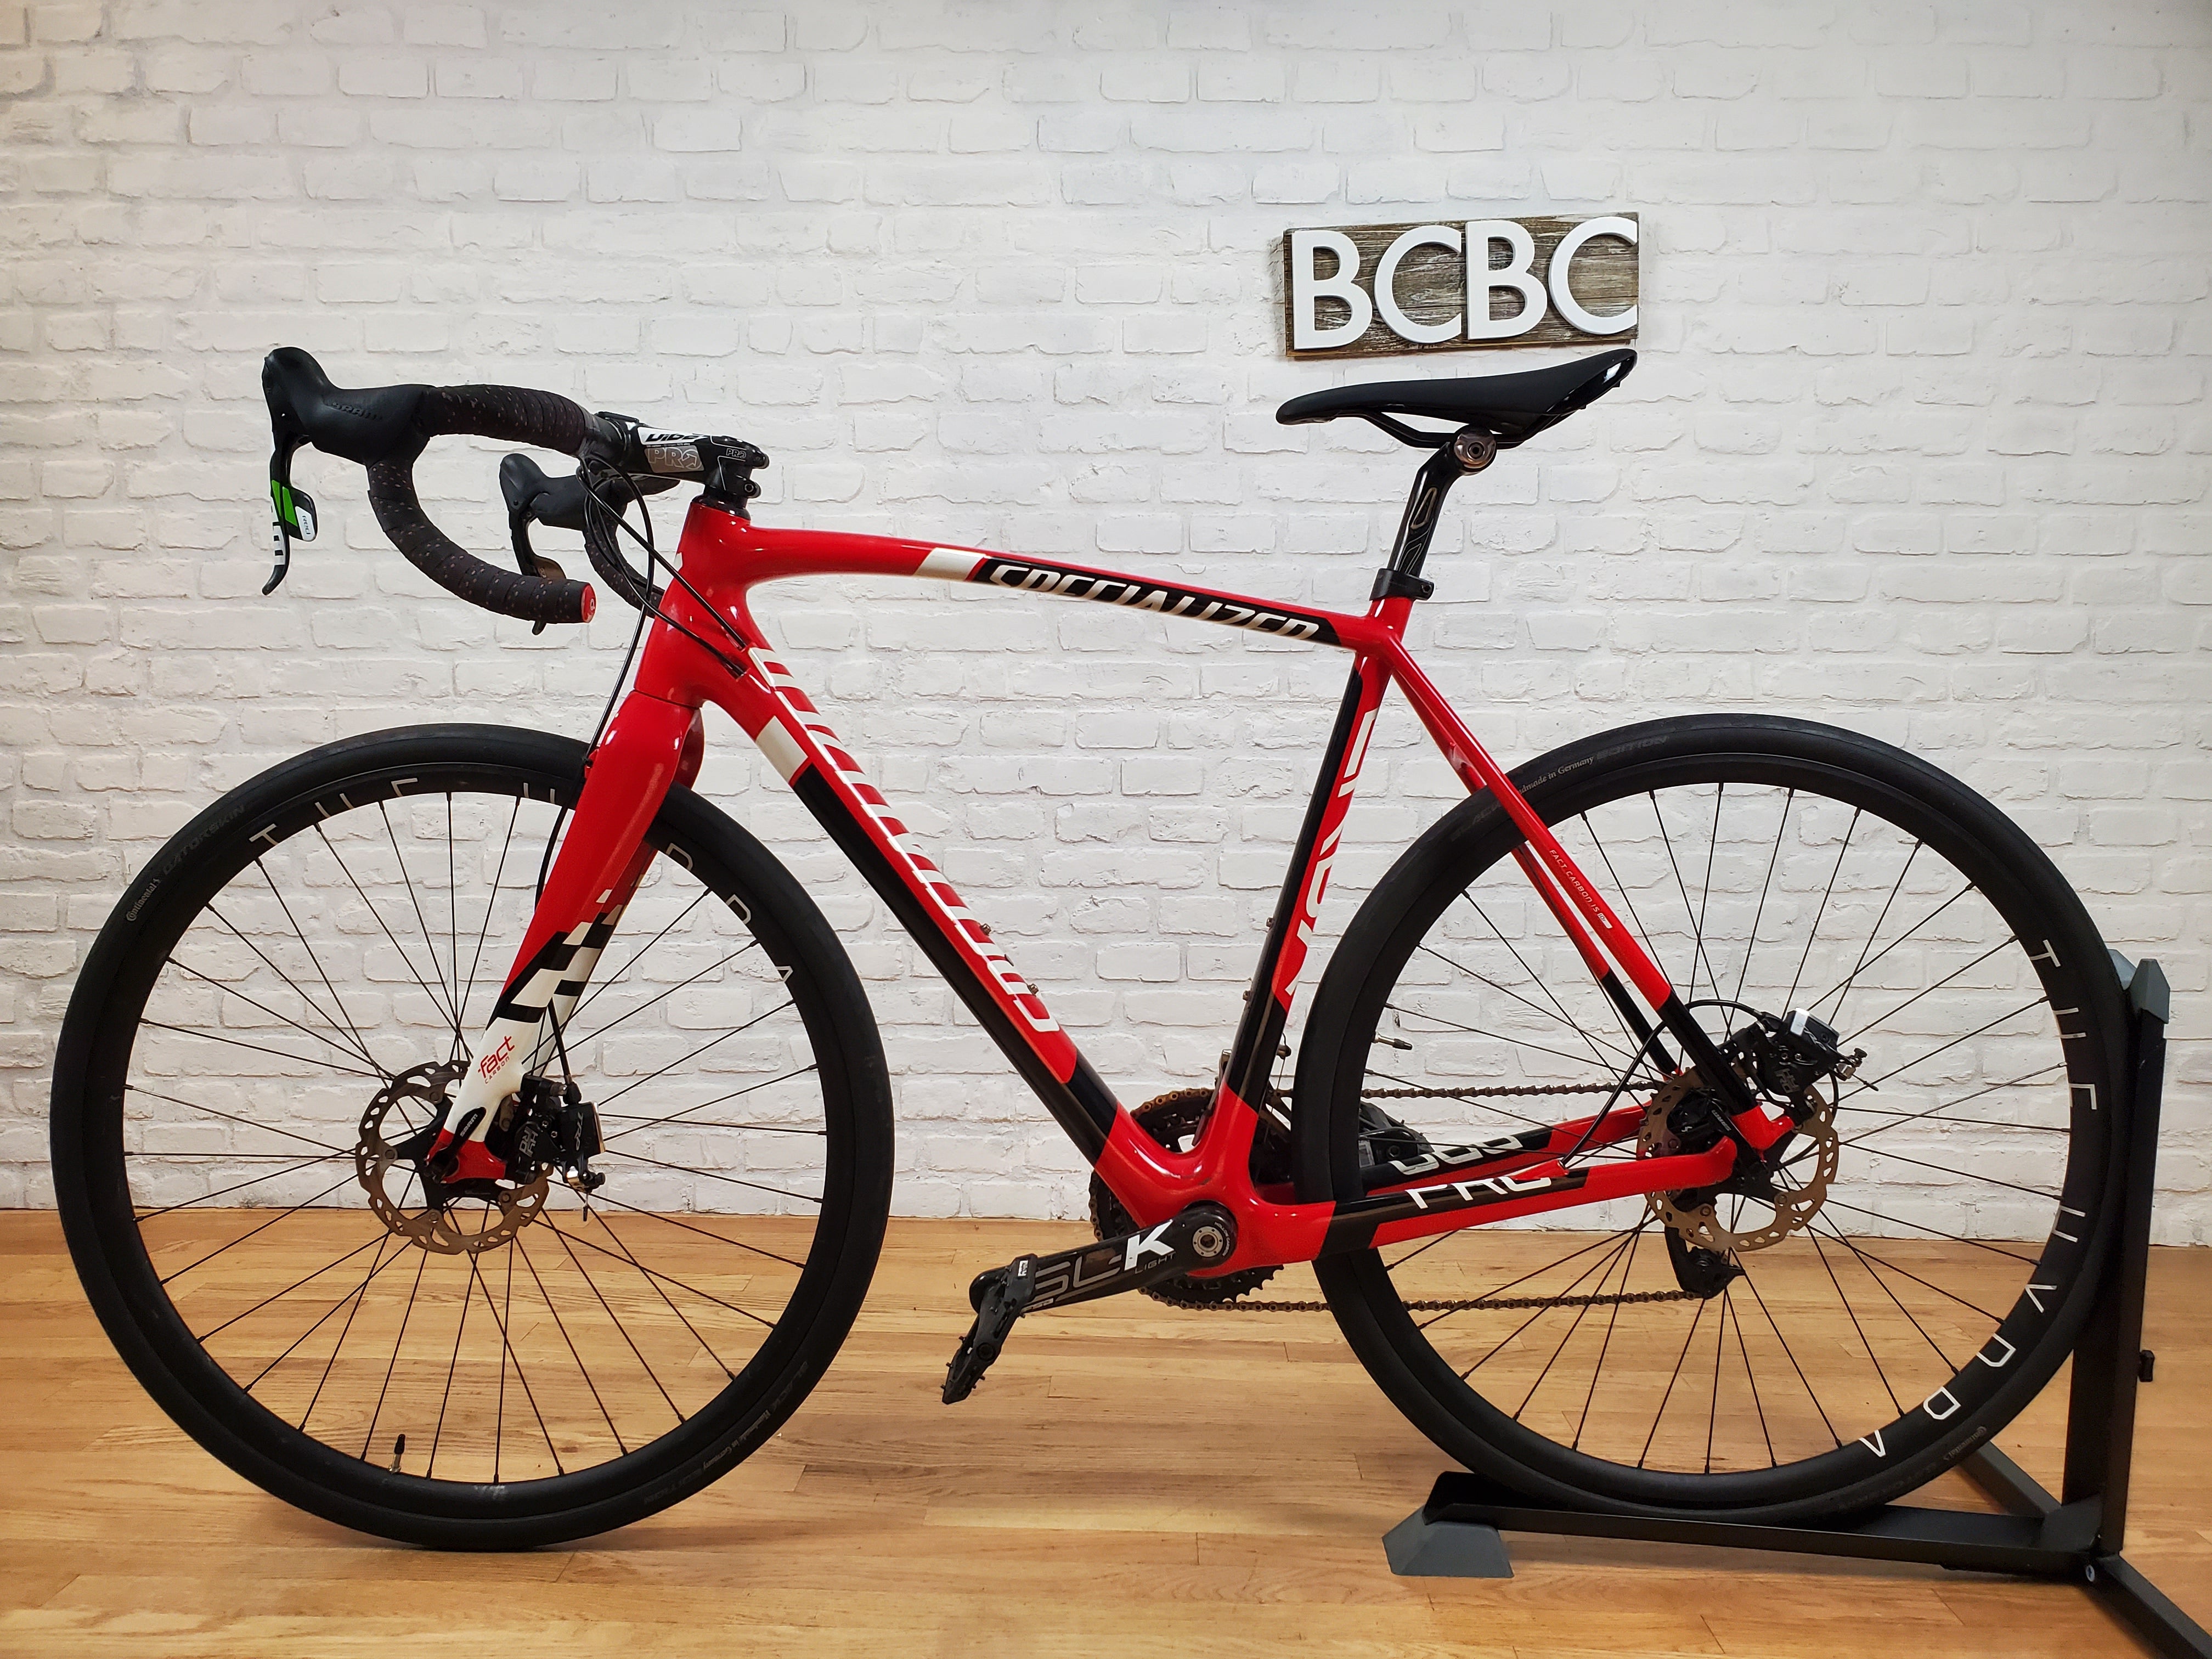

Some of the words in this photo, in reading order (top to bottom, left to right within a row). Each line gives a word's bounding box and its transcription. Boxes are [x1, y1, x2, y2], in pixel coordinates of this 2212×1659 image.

[1291, 216, 1638, 350] BCBC
[648, 446, 702, 470] PRO
[726, 448, 747, 459] PRO
[1558, 755, 1594, 775] Germany
[1550, 850, 1567, 868] FACT
[125, 879, 159, 922] Continental
[478, 1036, 515, 1079] fact
[460, 1114, 478, 1137] SRAM
[574, 1111, 584, 1152] TRP
[1135, 1251, 1176, 1274] LIGHT
